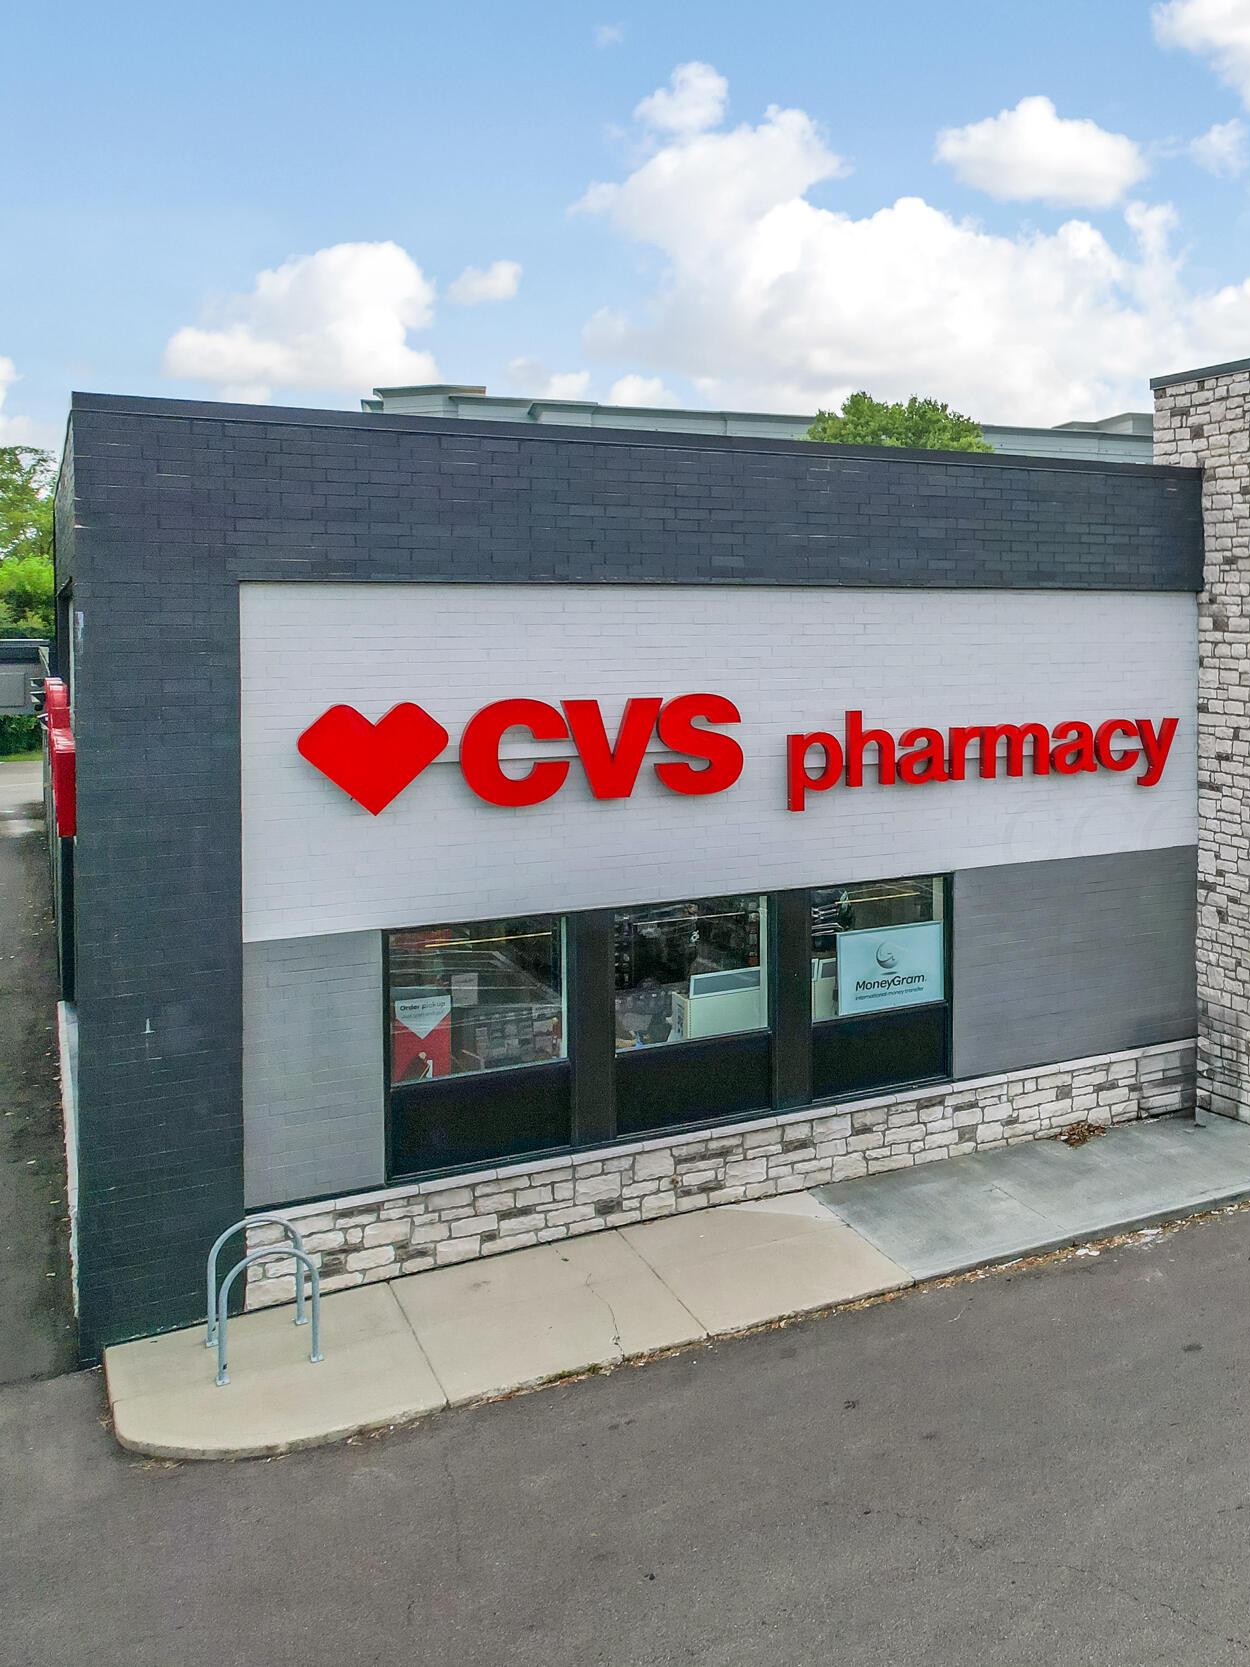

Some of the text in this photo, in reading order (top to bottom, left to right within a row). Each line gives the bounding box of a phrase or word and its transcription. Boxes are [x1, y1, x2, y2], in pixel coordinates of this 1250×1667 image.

[459, 693, 1180, 812] CVS pharmacy
[855, 974, 926, 992] MoneyGram
[855, 991, 888, 1001] international
[904, 986, 924, 994] transfer
[400, 1003, 420, 1011] Order
